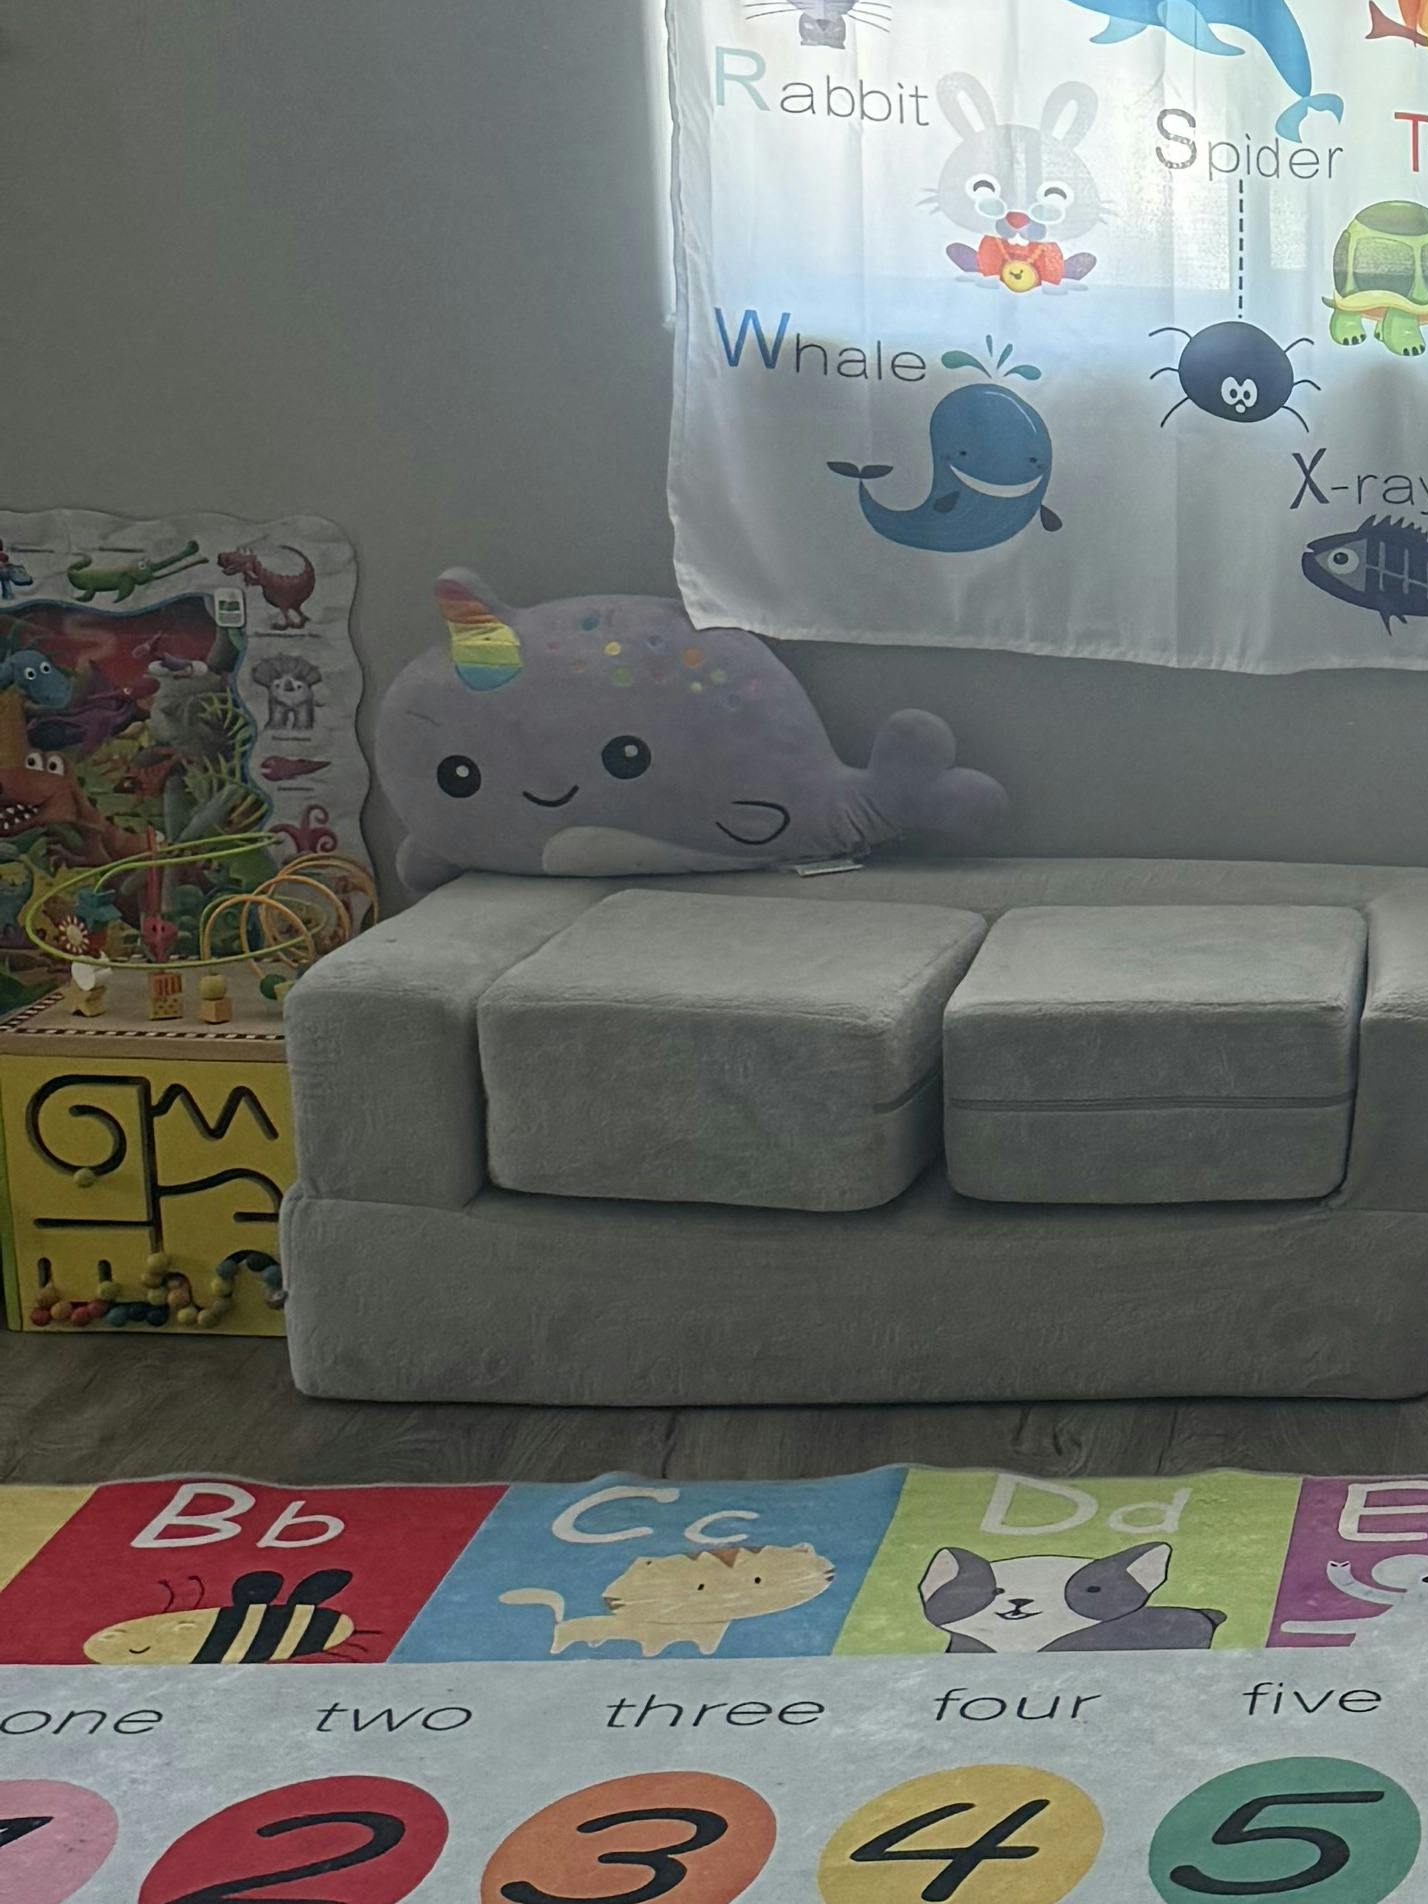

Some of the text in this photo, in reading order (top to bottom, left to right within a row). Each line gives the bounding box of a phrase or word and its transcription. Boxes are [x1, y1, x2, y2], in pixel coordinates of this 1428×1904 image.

[713, 46, 930, 128] Rabbit
[1154, 107, 1344, 181] Spider
[713, 307, 927, 384] Whale
[129, 1482, 347, 1551] Bb
[550, 1485, 759, 1545] Cc
[979, 1473, 1191, 1537] Dd
[1, 1708, 163, 1735] one
[315, 1699, 474, 1735] two
[604, 1691, 827, 1730] three
[931, 1687, 1102, 1725] four
[1242, 1680, 1384, 1717] five
[848, 1799, 1051, 1904] 4
[1168, 1789, 1386, 1897] 5
